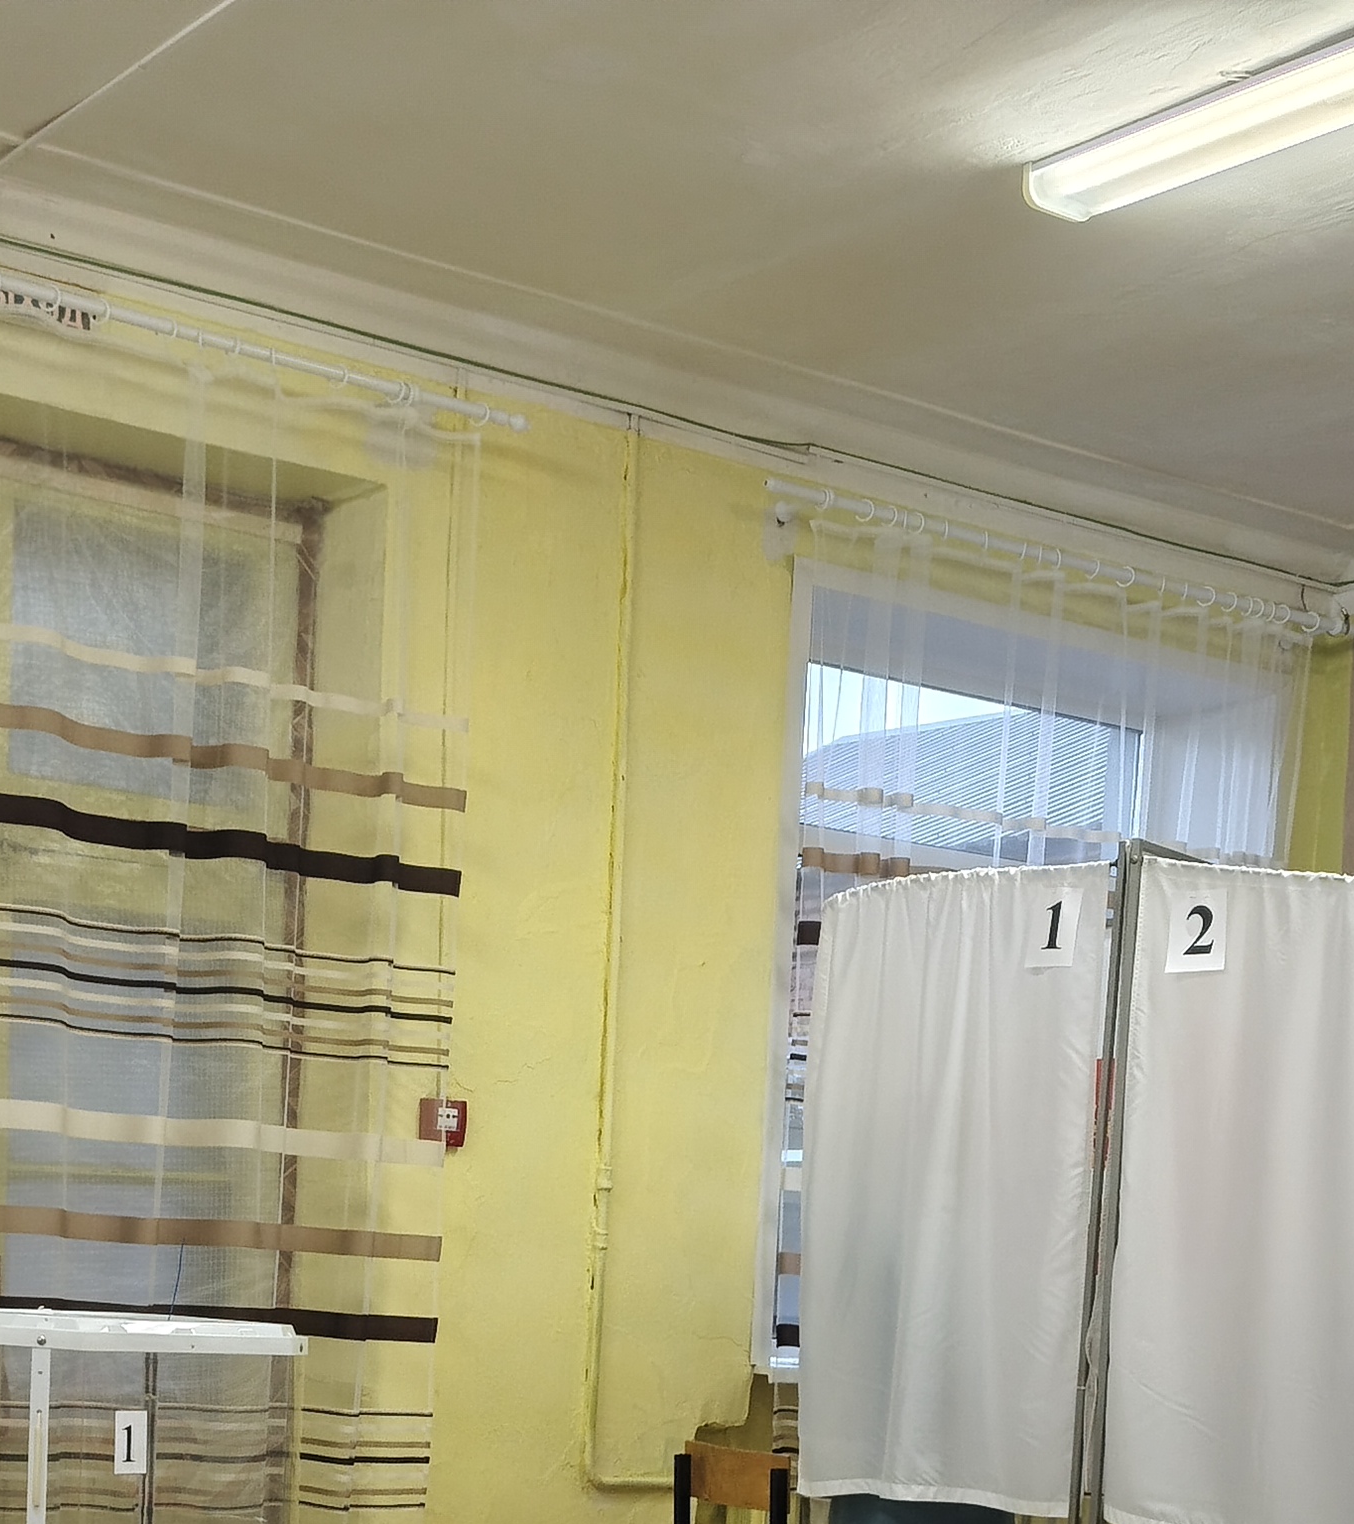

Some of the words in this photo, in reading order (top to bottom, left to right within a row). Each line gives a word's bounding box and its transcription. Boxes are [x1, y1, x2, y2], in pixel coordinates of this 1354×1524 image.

[1041, 900, 1063, 950] 1
[1183, 904, 1215, 956] 2
[121, 1424, 136, 1463] 1
